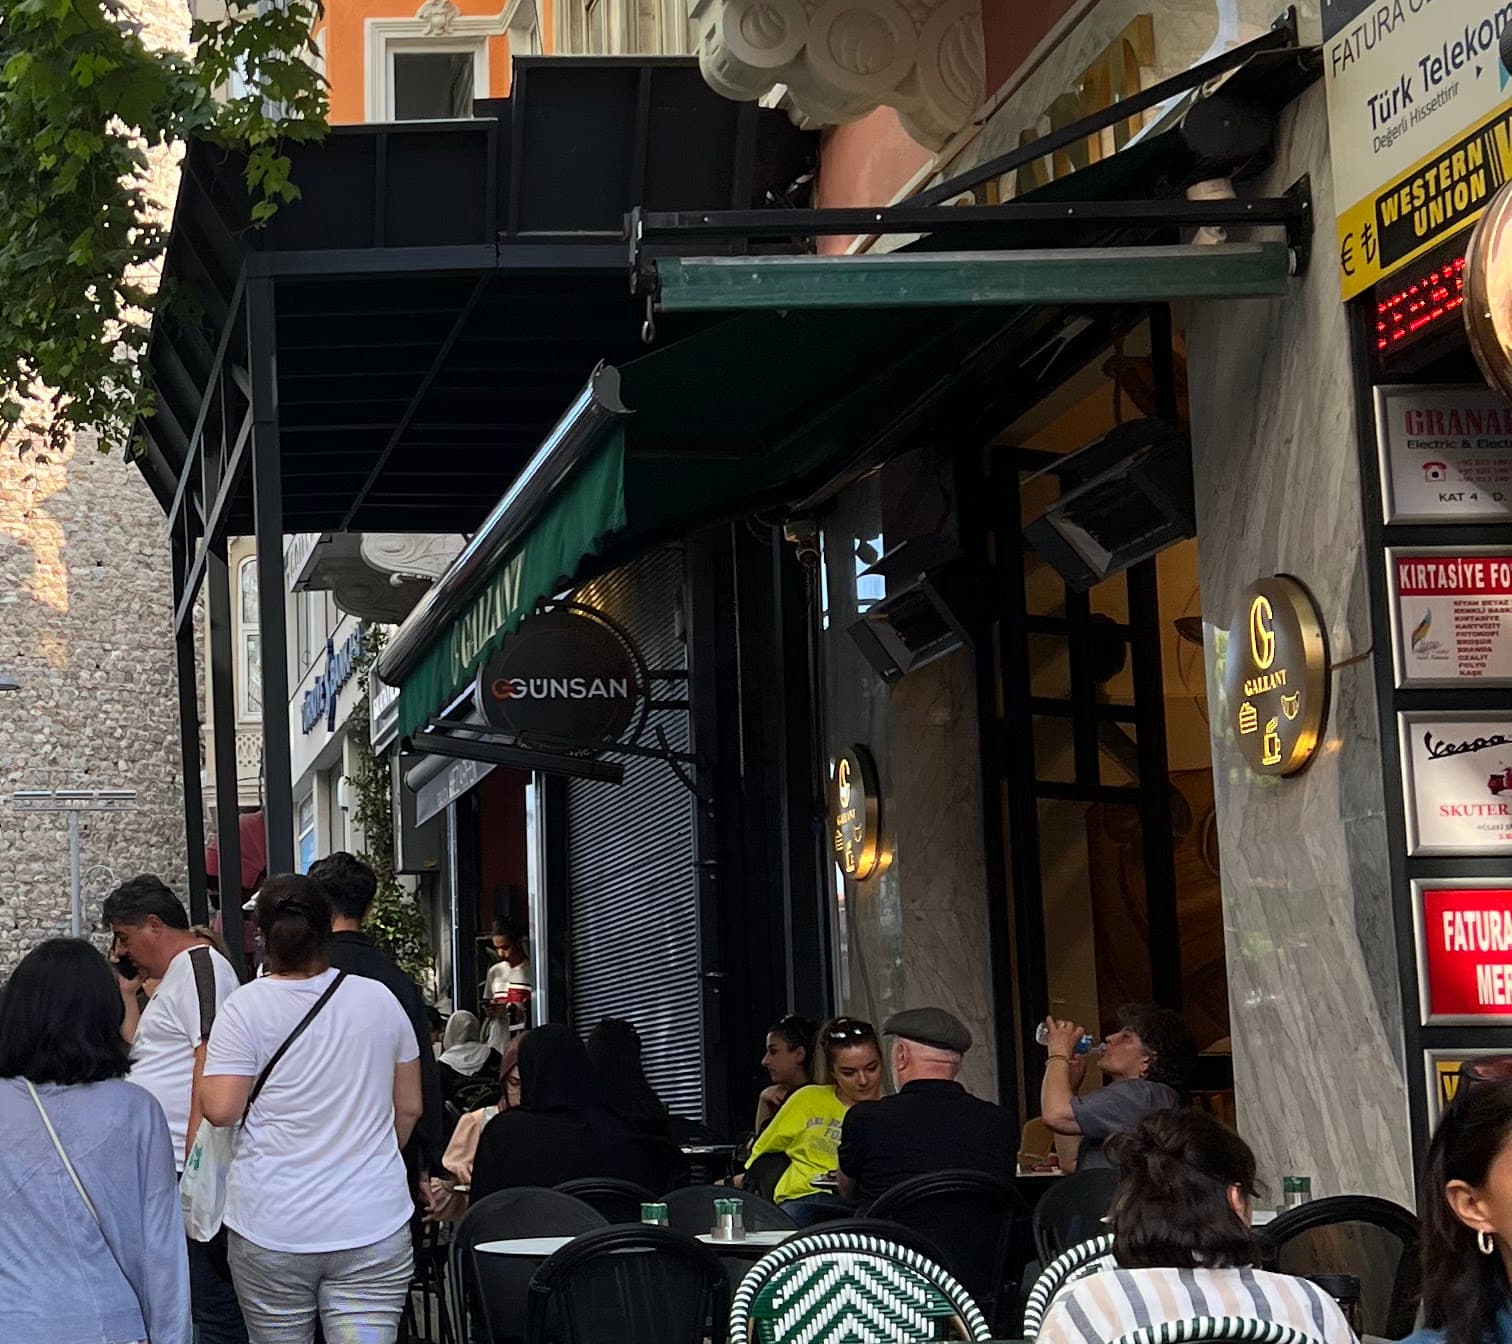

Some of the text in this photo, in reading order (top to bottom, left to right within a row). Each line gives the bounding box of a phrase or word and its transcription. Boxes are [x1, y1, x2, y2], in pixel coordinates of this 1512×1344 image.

[1367, 73, 1414, 131] Türk
[1381, 138, 1484, 227] WESTERN
[1414, 168, 1487, 238] UNION
[1439, 492, 1465, 502] KAT
[1399, 558, 1512, 589] KIRTASİYE FO
[1244, 669, 1287, 697] GALLANT
[1424, 731, 1512, 760] Vespa
[1439, 803, 1509, 817] SKUTER
[1442, 910, 1512, 952] FATURA
